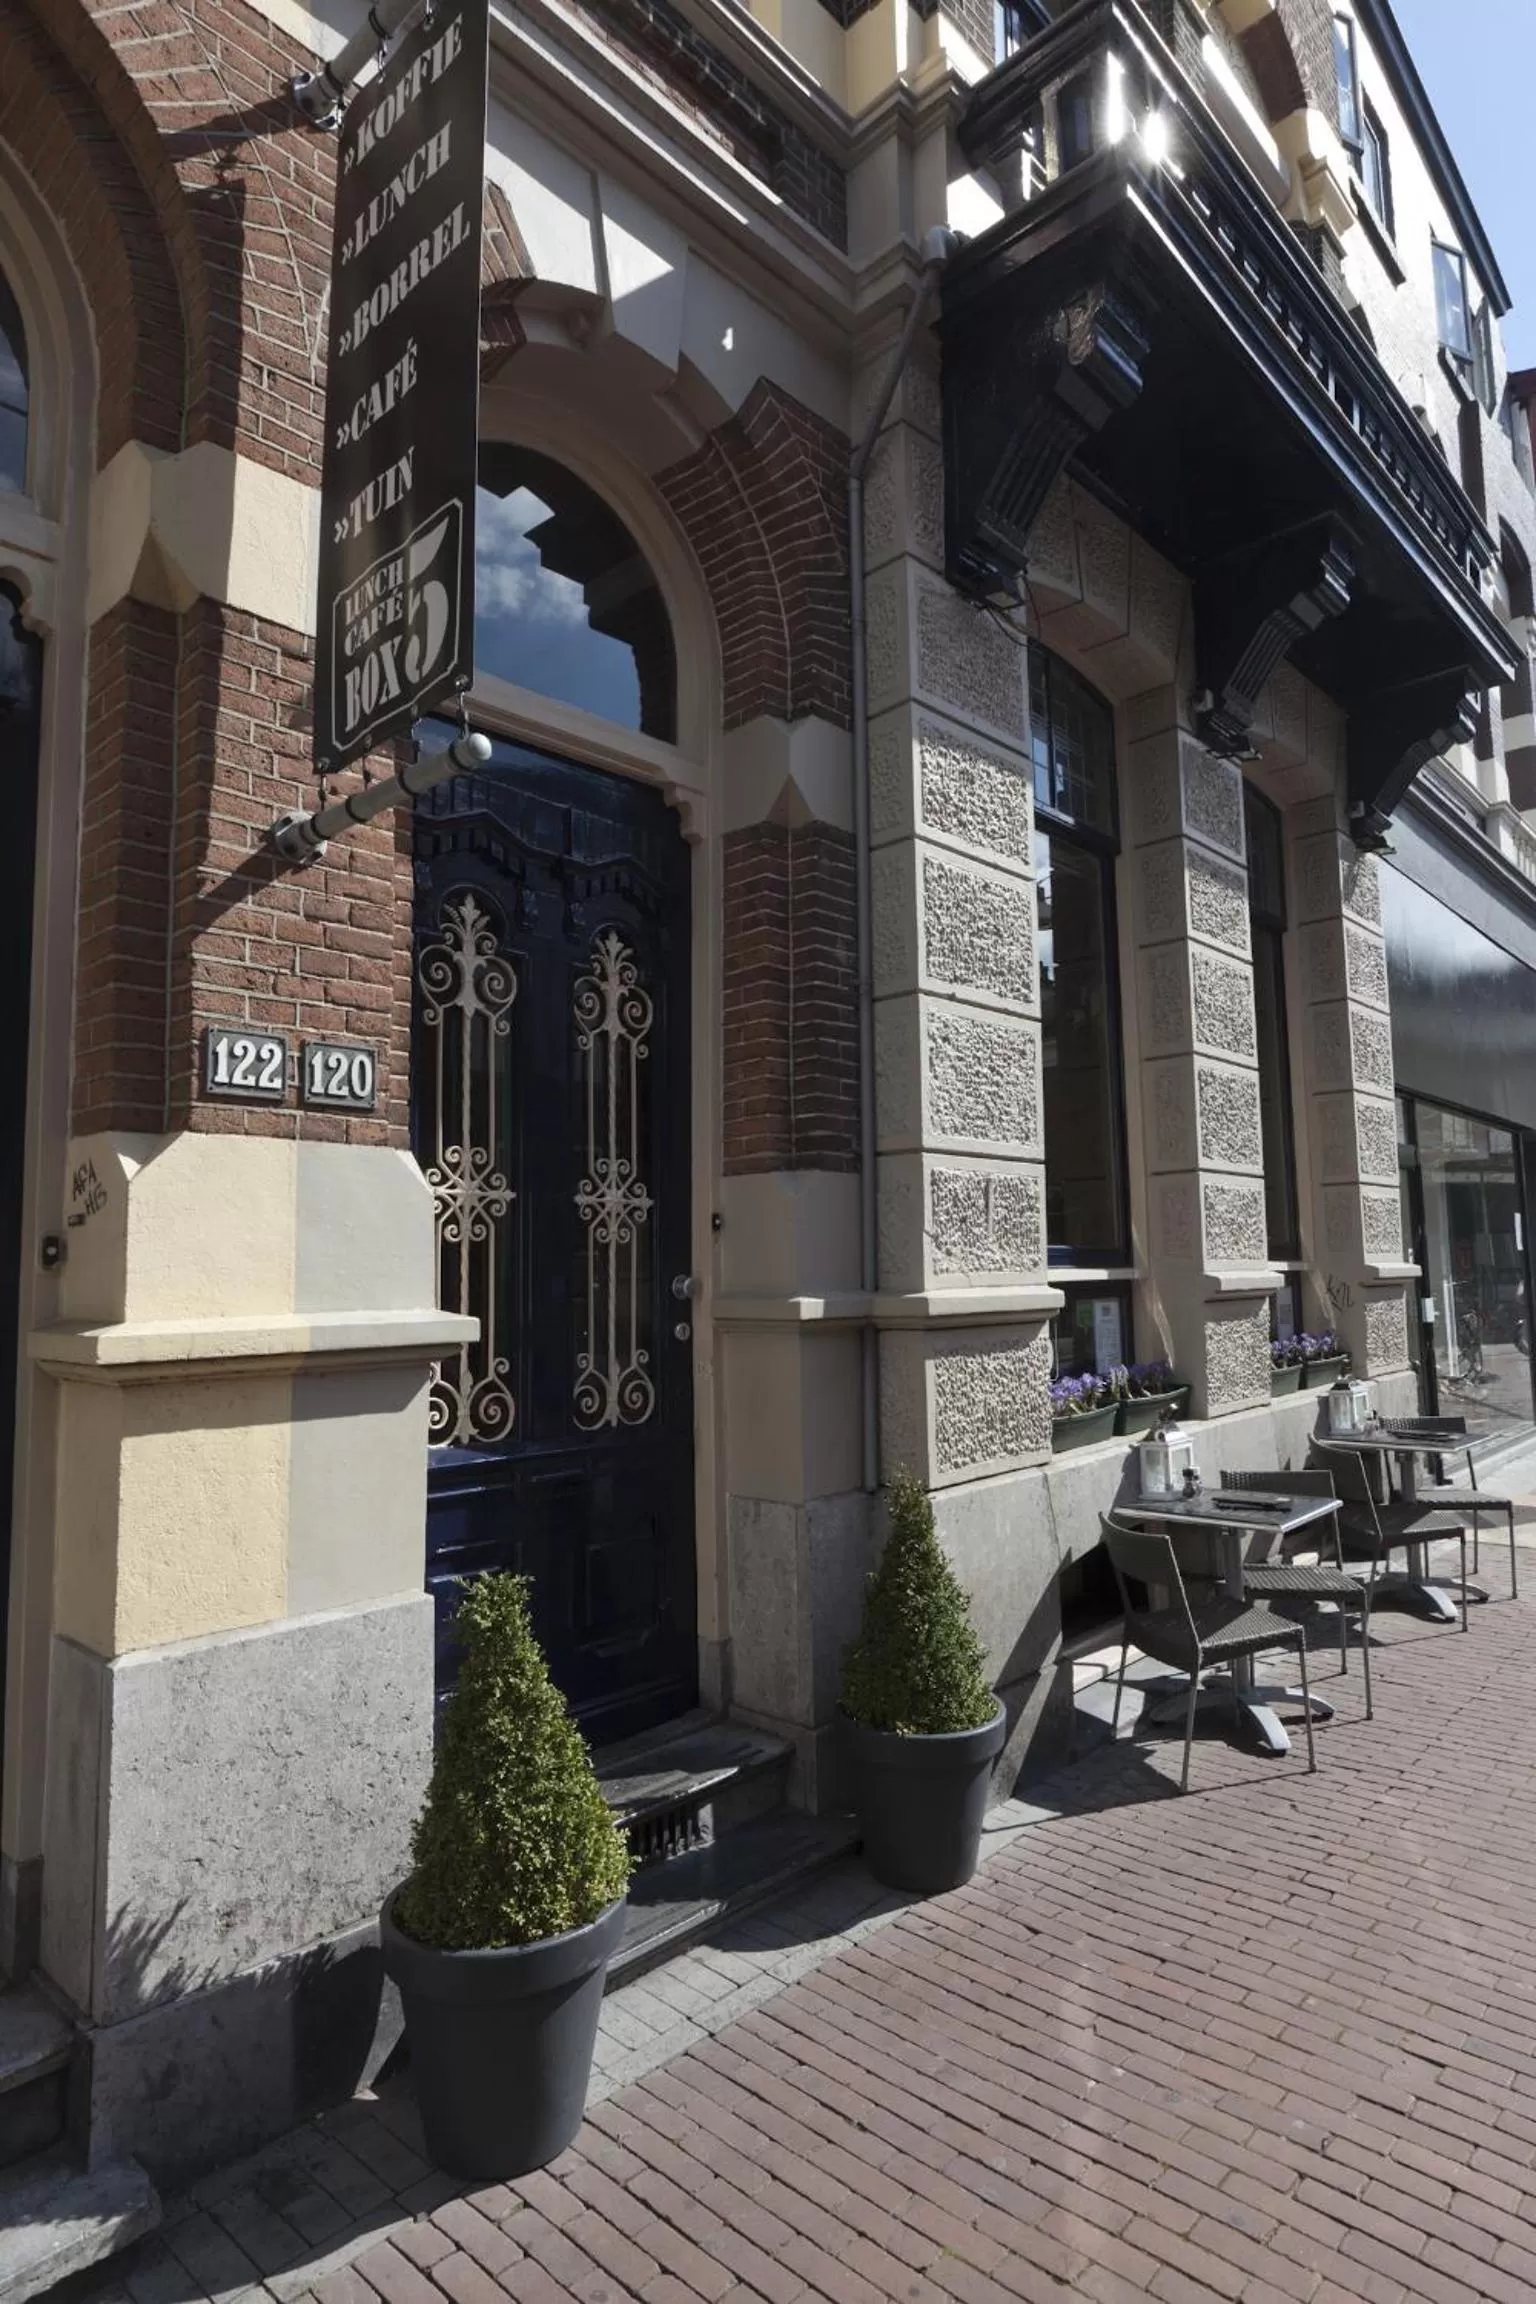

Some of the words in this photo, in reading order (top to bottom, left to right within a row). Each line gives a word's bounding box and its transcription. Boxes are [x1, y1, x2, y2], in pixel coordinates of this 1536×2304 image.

[344, 557, 404, 625] LUNCH
[344, 588, 404, 657] CAFÉ
[344, 634, 402, 733] BOX
[214, 1037, 283, 1089] 122
[311, 1051, 372, 1097] 120
